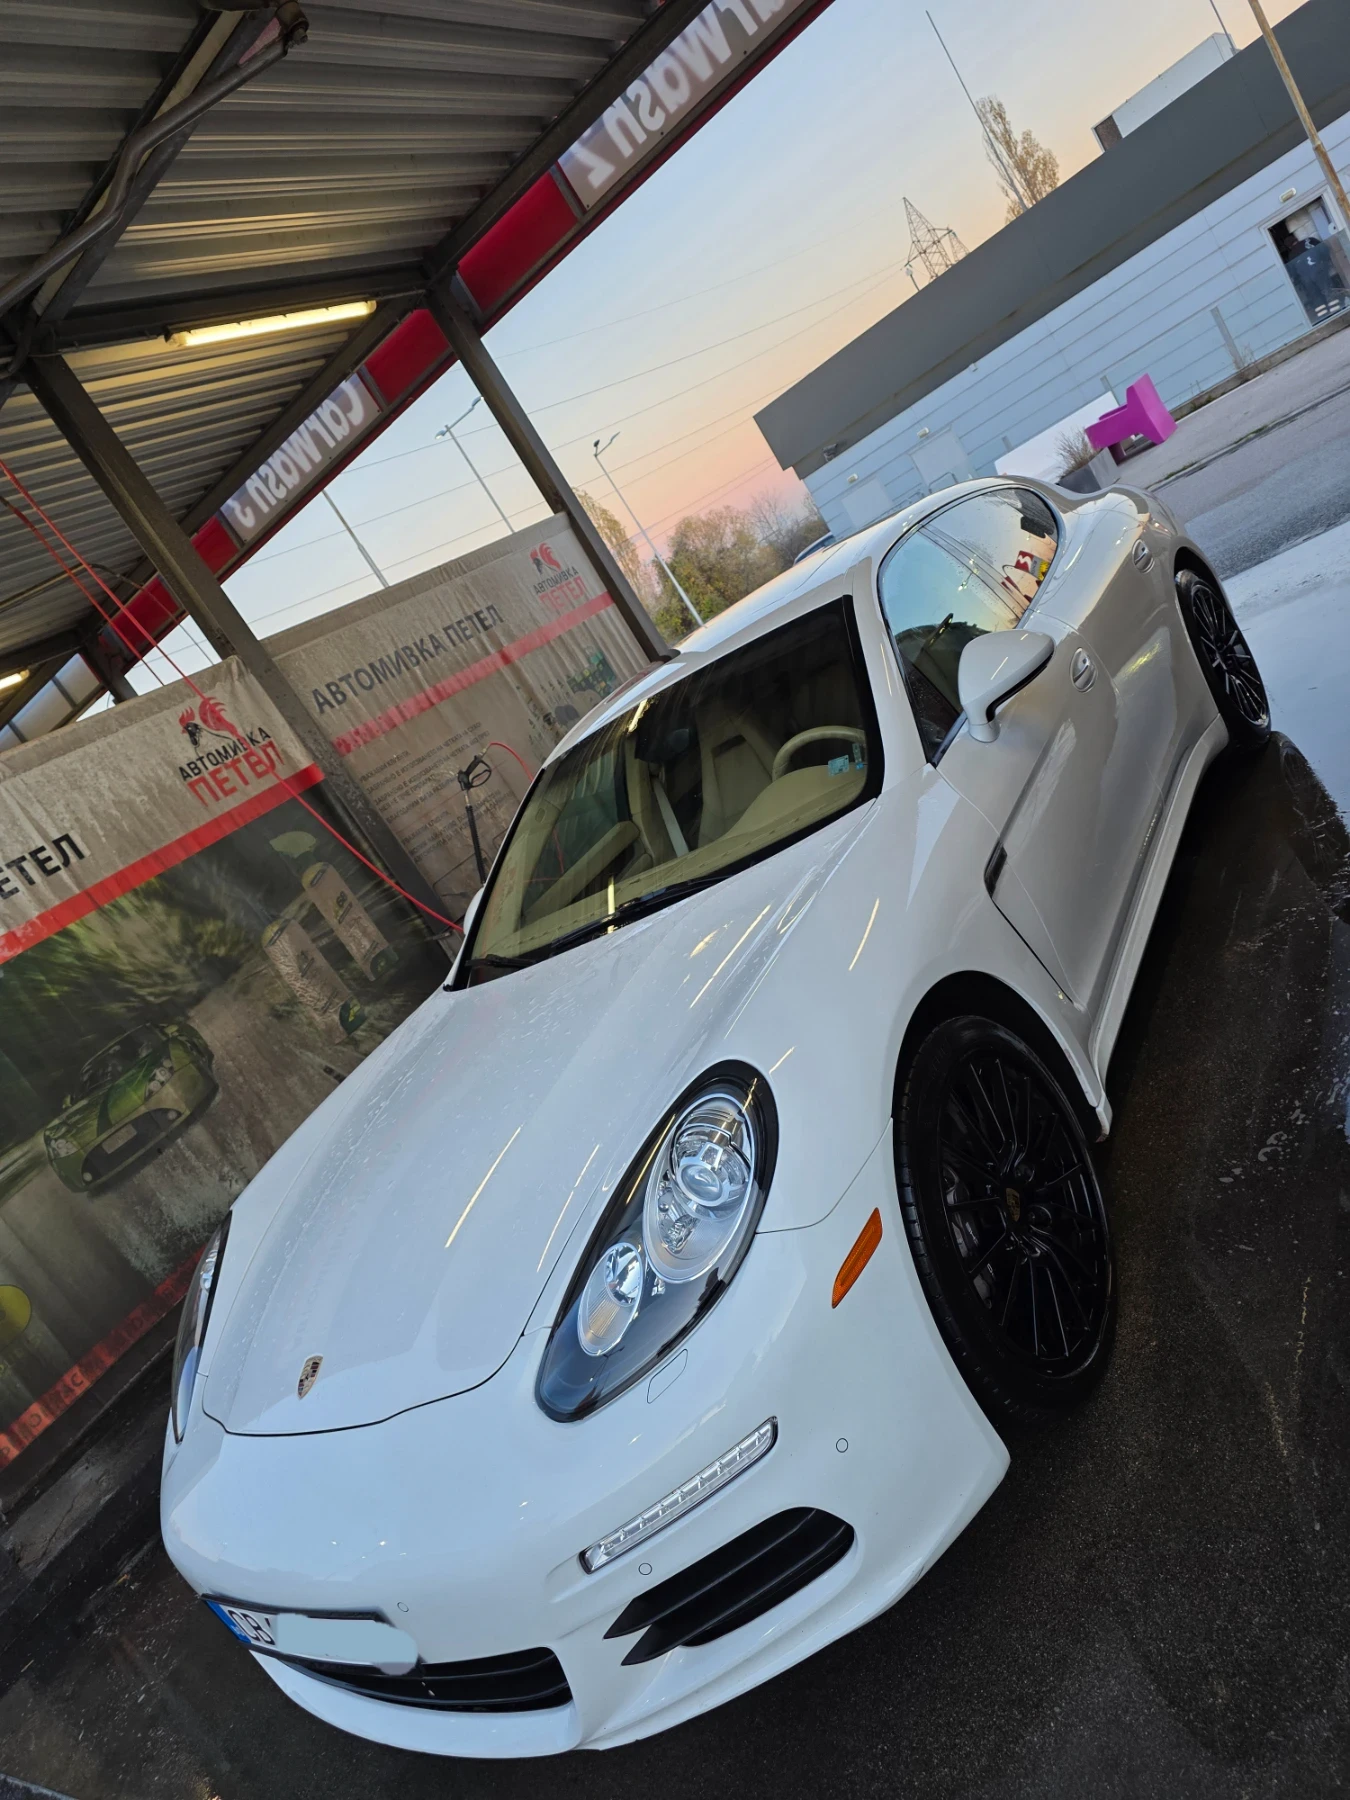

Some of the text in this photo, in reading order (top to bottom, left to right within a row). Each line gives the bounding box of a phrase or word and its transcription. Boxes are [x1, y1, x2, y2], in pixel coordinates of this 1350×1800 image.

[533, 566, 579, 594] АВТОМИВКА
[538, 575, 590, 609] ПЕТЕЛ
[312, 604, 504, 714] АВТОМИВКА ПЕТЕЛ
